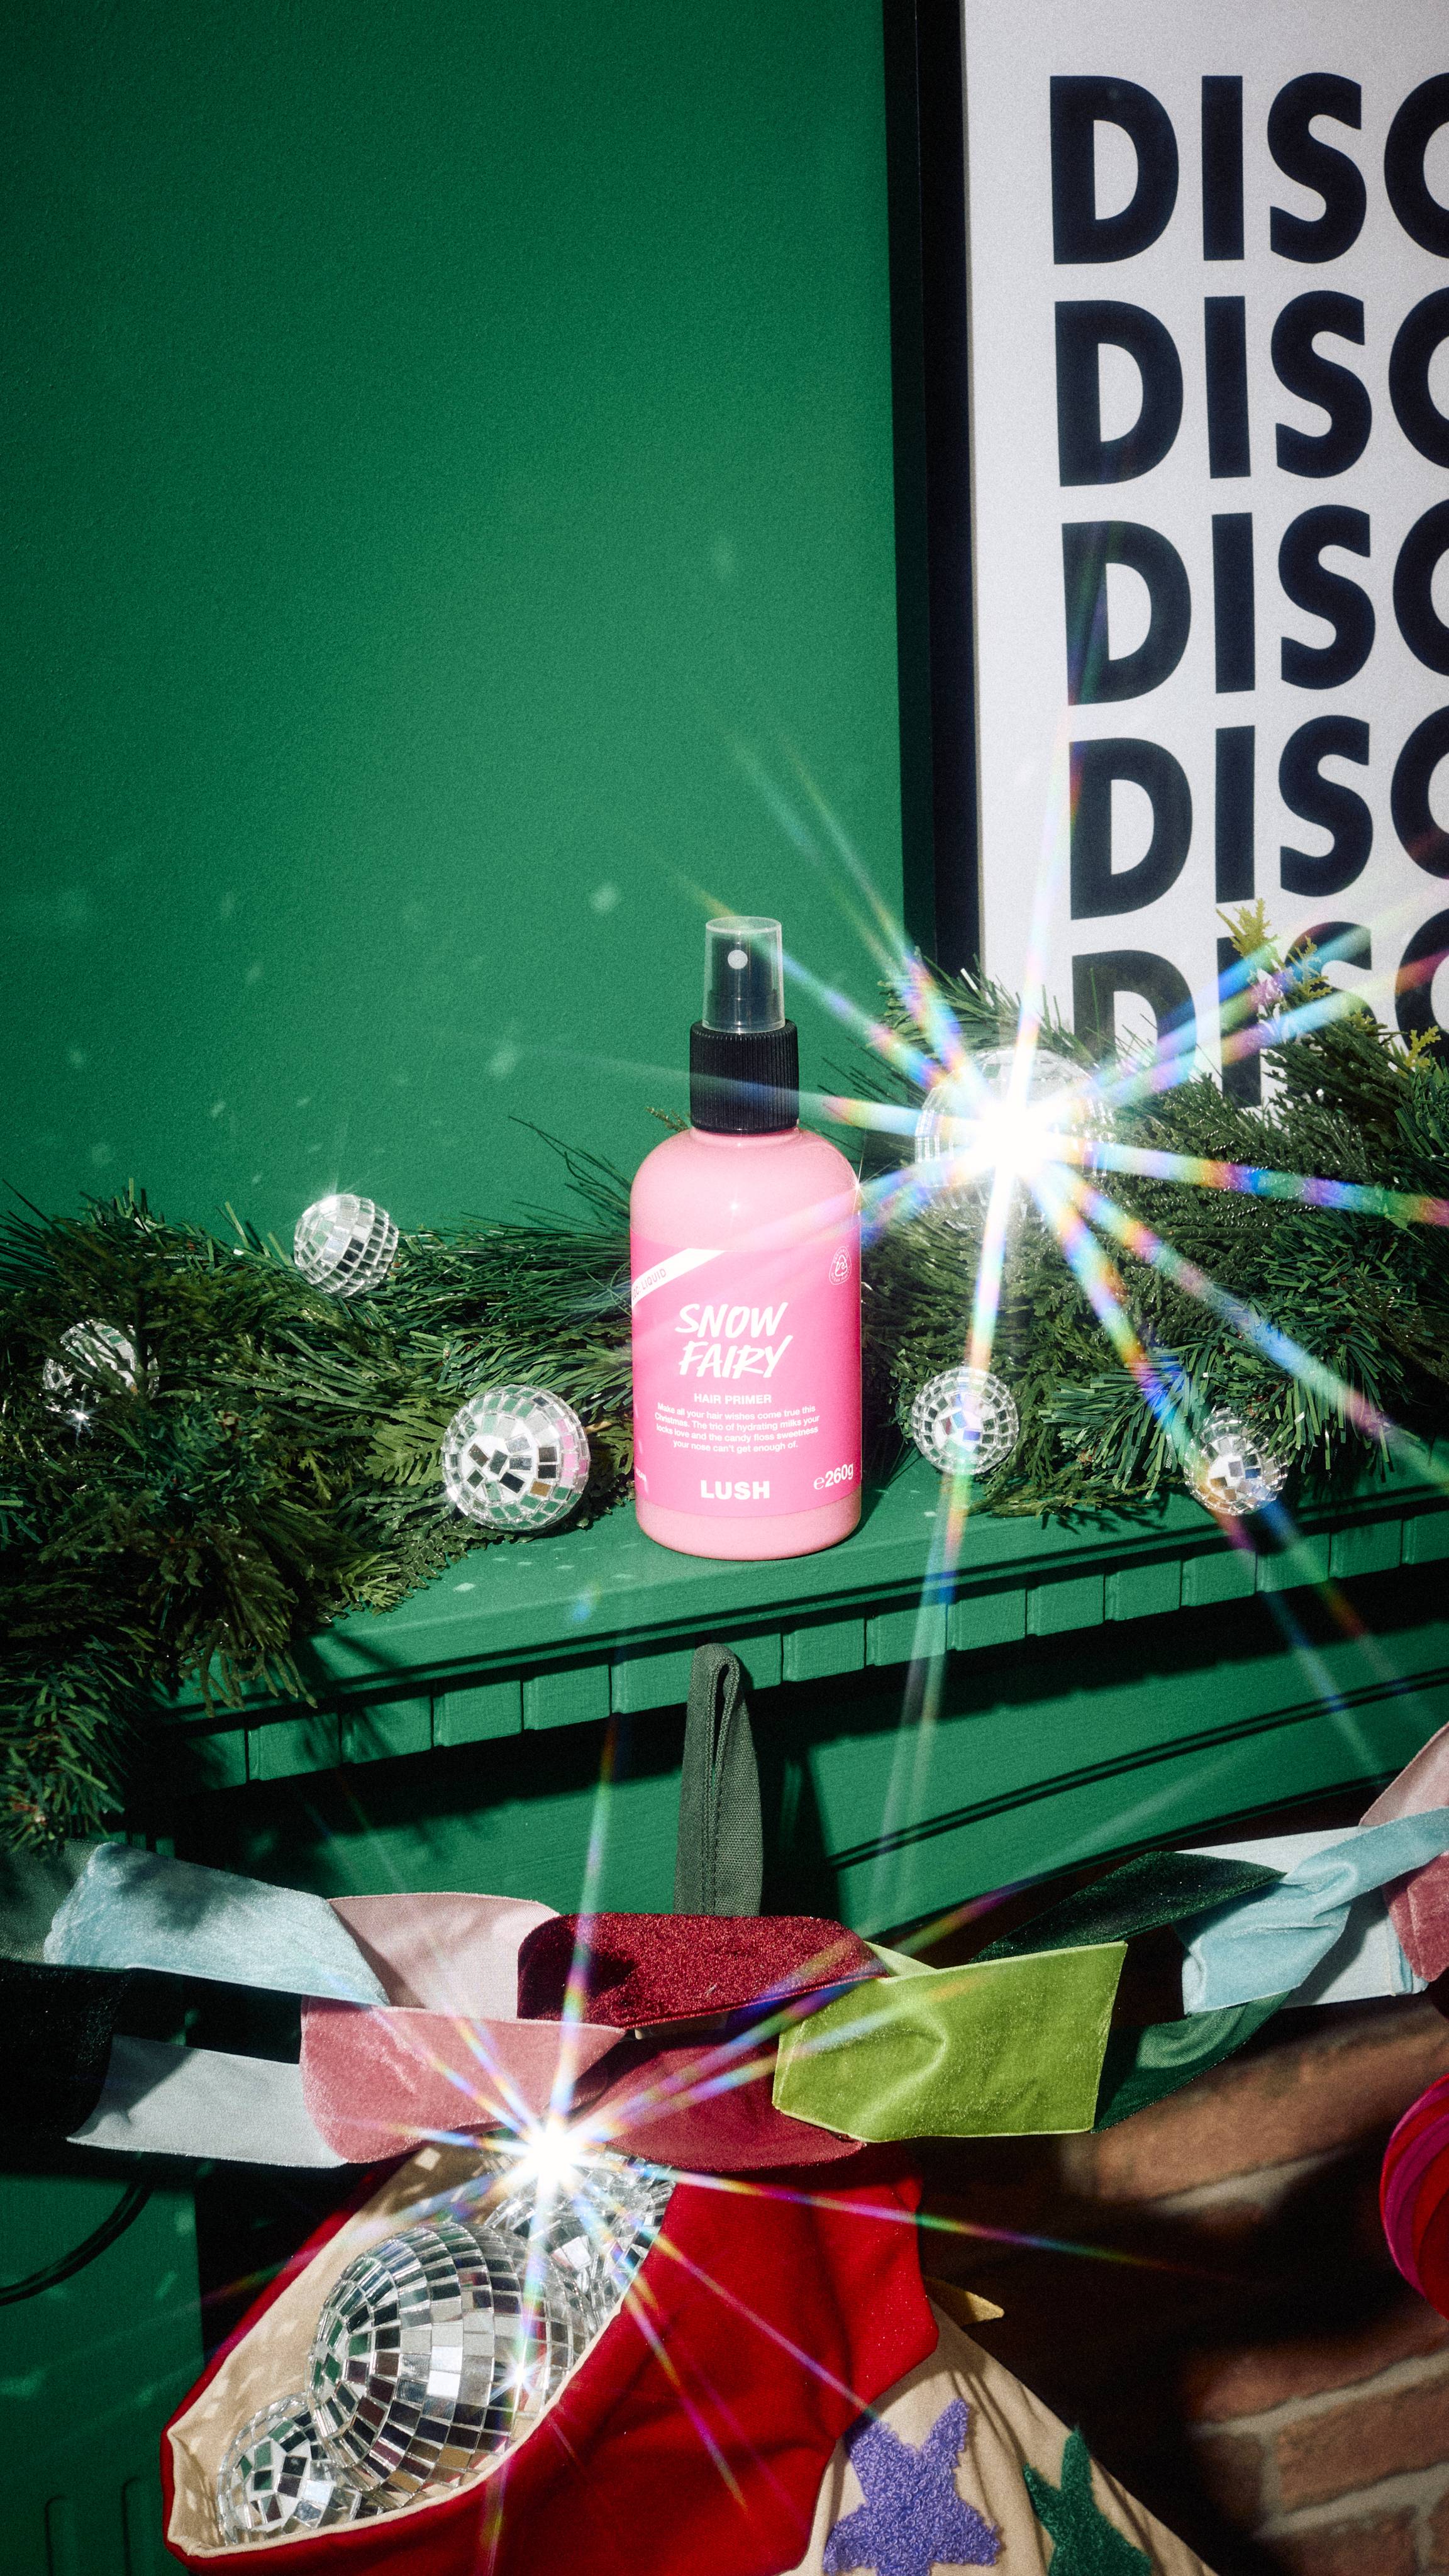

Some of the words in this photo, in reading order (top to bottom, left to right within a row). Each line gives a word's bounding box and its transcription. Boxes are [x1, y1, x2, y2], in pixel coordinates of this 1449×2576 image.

[641, 1269, 667, 1290] LIQUID
[674, 1302, 789, 1338] SNOW
[678, 1335, 794, 1379] FAIRY
[694, 1393, 721, 1404] HAIR
[724, 1394, 772, 1404] PRIMER
[657, 1402, 675, 1414] Make
[706, 1411, 723, 1419] hair
[757, 1411, 782, 1419] come
[784, 1409, 800, 1417] true
[802, 1405, 816, 1414] this
[655, 1412, 690, 1428] Christmas.
[692, 1420, 707, 1430] The
[726, 1423, 735, 1431] of
[736, 1422, 778, 1433] hydrating
[780, 1419, 802, 1428] milks
[803, 1415, 820, 1426] your
[656, 1423, 673, 1435] locks
[674, 1428, 690, 1438] love
[709, 1433, 723, 1441] the
[724, 1434, 751, 1443] candy
[777, 1426, 818, 1440] sweetness
[673, 1440, 689, 1448] your
[691, 1443, 711, 1452] nose
[736, 1445, 751, 1454] get
[753, 1442, 786, 1452] enough
[787, 1440, 798, 1448] of.
[700, 1479, 770, 1500] LUSH
